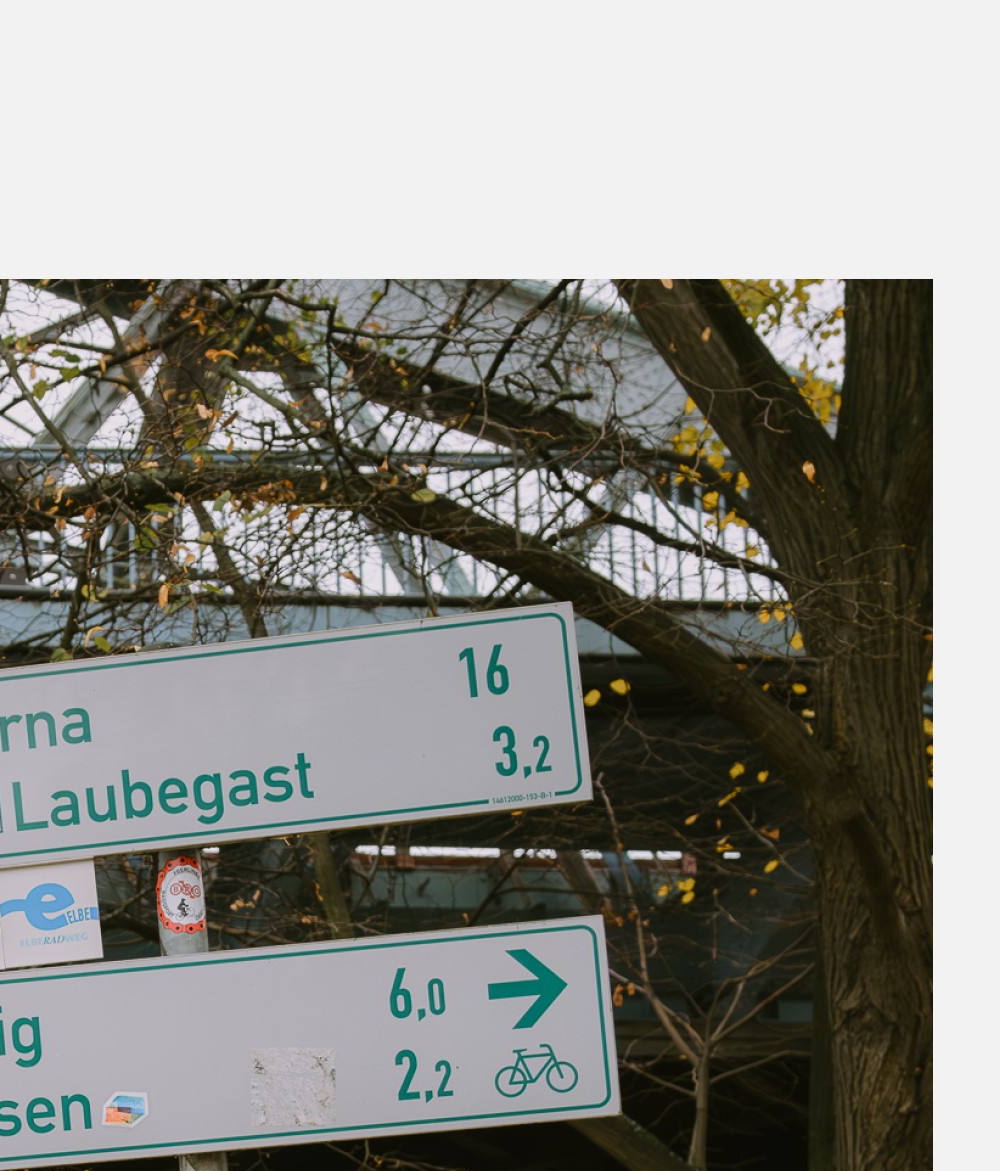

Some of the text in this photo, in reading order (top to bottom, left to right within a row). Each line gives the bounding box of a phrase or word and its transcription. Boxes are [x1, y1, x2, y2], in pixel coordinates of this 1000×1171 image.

[459, 643, 510, 699] 16
[493, 724, 553, 779] 3,2
[12, 752, 316, 831] Laubegast
[20, 932, 89, 948] ELBERADWEG
[66, 907, 91, 925] ELBE
[389, 967, 447, 1022] 6,0
[395, 1049, 455, 1103] 2,2
